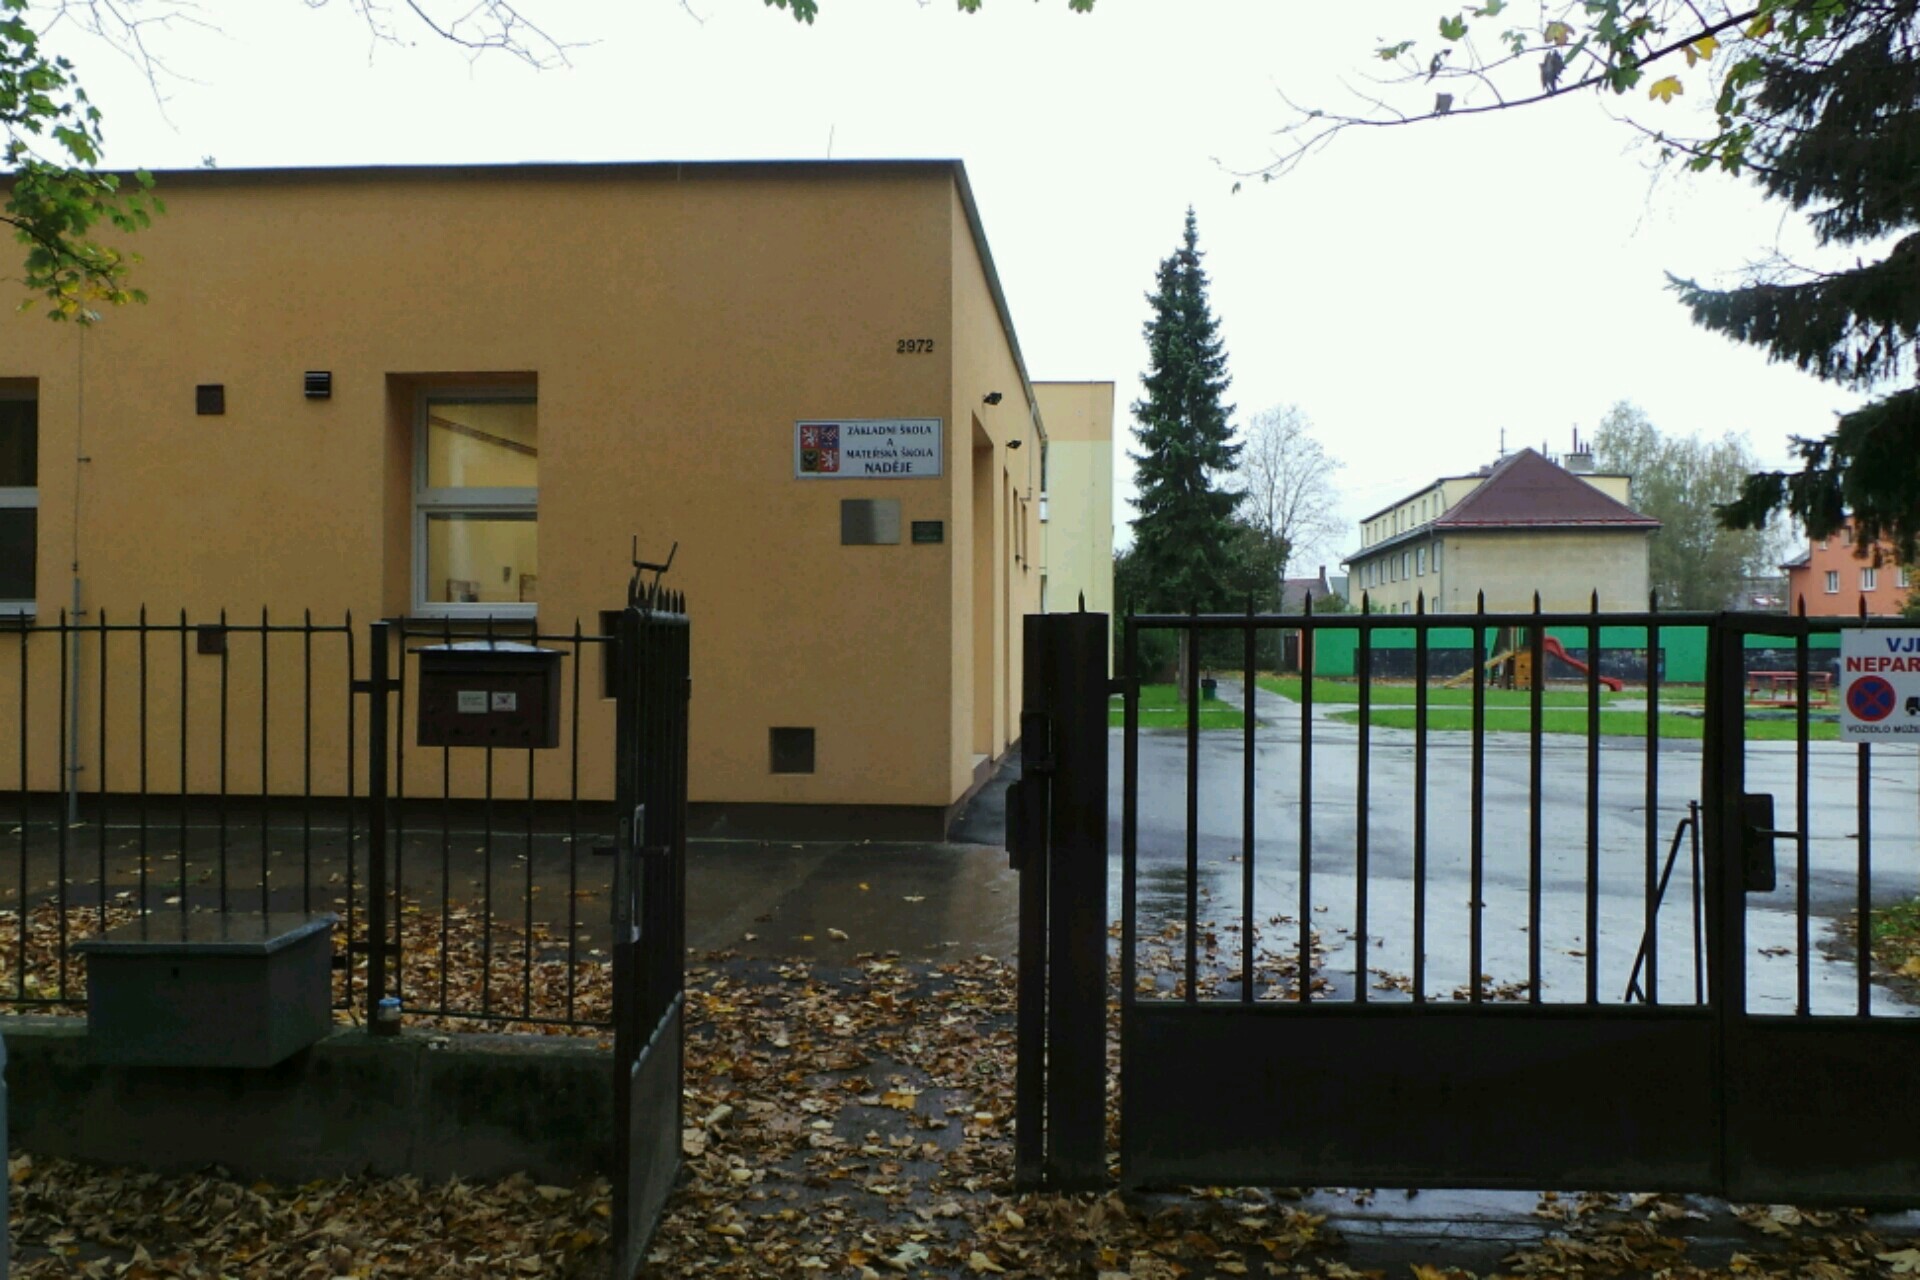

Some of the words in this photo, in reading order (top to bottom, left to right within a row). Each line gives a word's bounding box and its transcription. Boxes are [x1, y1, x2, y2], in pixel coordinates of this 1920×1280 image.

[897, 339, 933, 353] 2972
[900, 425, 932, 435] ŠKOLA
[886, 438, 894, 447] A
[901, 446, 933, 457] ŠKOLA
[864, 460, 913, 473] NADĚJE
[1847, 724, 1890, 733] VOZIDLO
